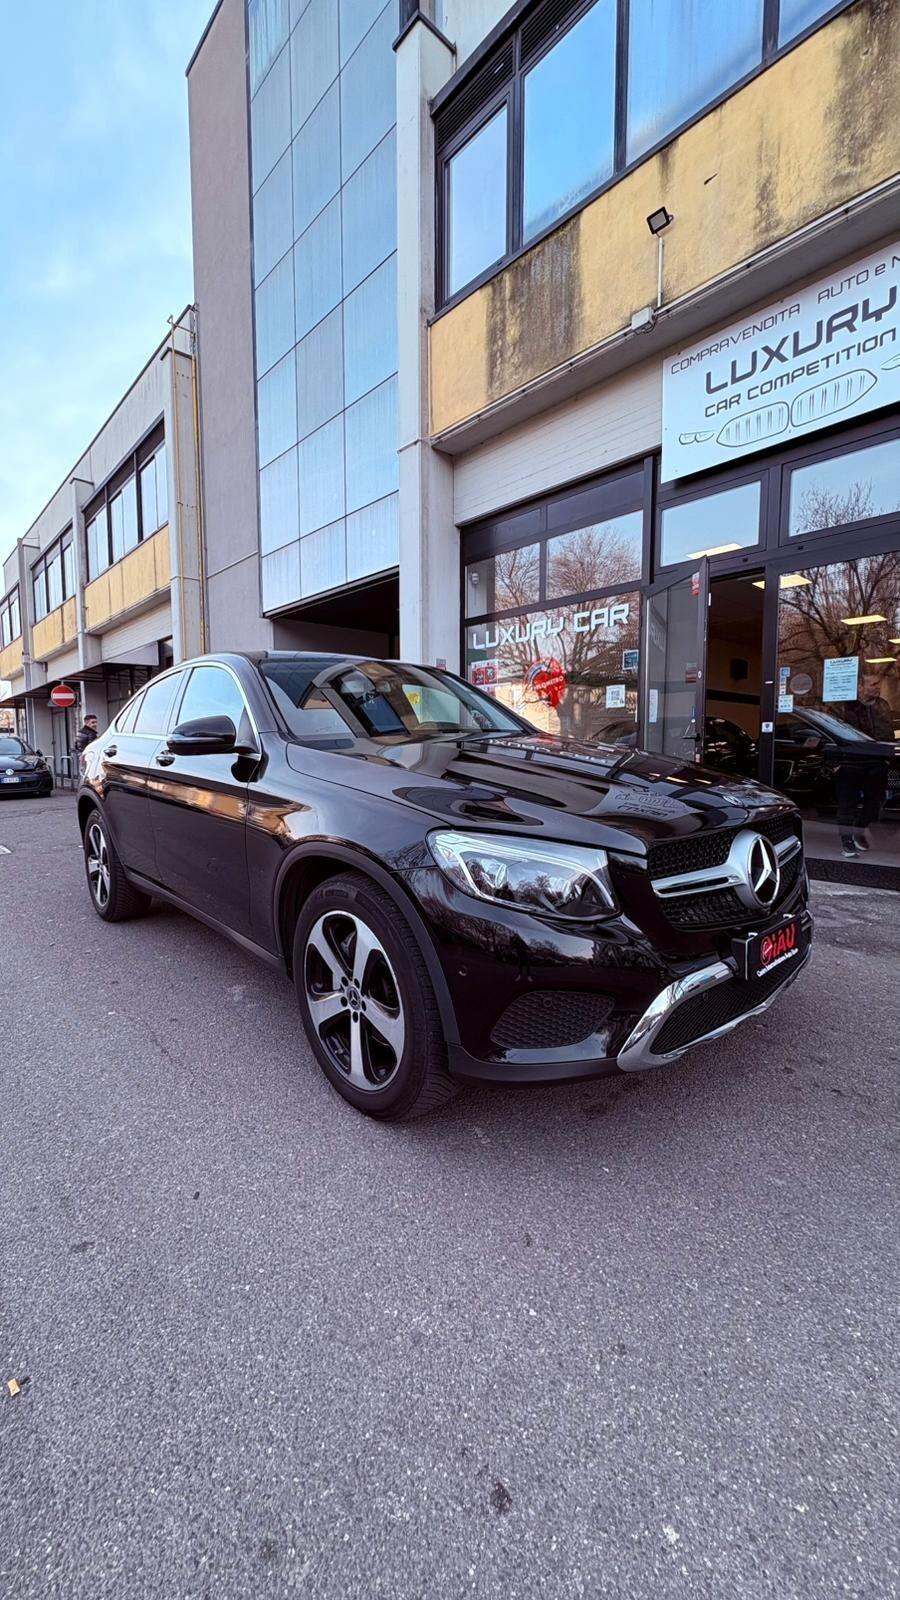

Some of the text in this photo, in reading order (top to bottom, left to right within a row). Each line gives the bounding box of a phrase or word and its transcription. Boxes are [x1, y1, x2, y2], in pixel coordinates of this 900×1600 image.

[671, 263, 886, 375] COMPRAVENDITA AUTO e
[705, 285, 898, 394] LUXURY
[705, 327, 897, 418] CAR COMPETITION
[473, 603, 630, 650] LUXURY CAR
